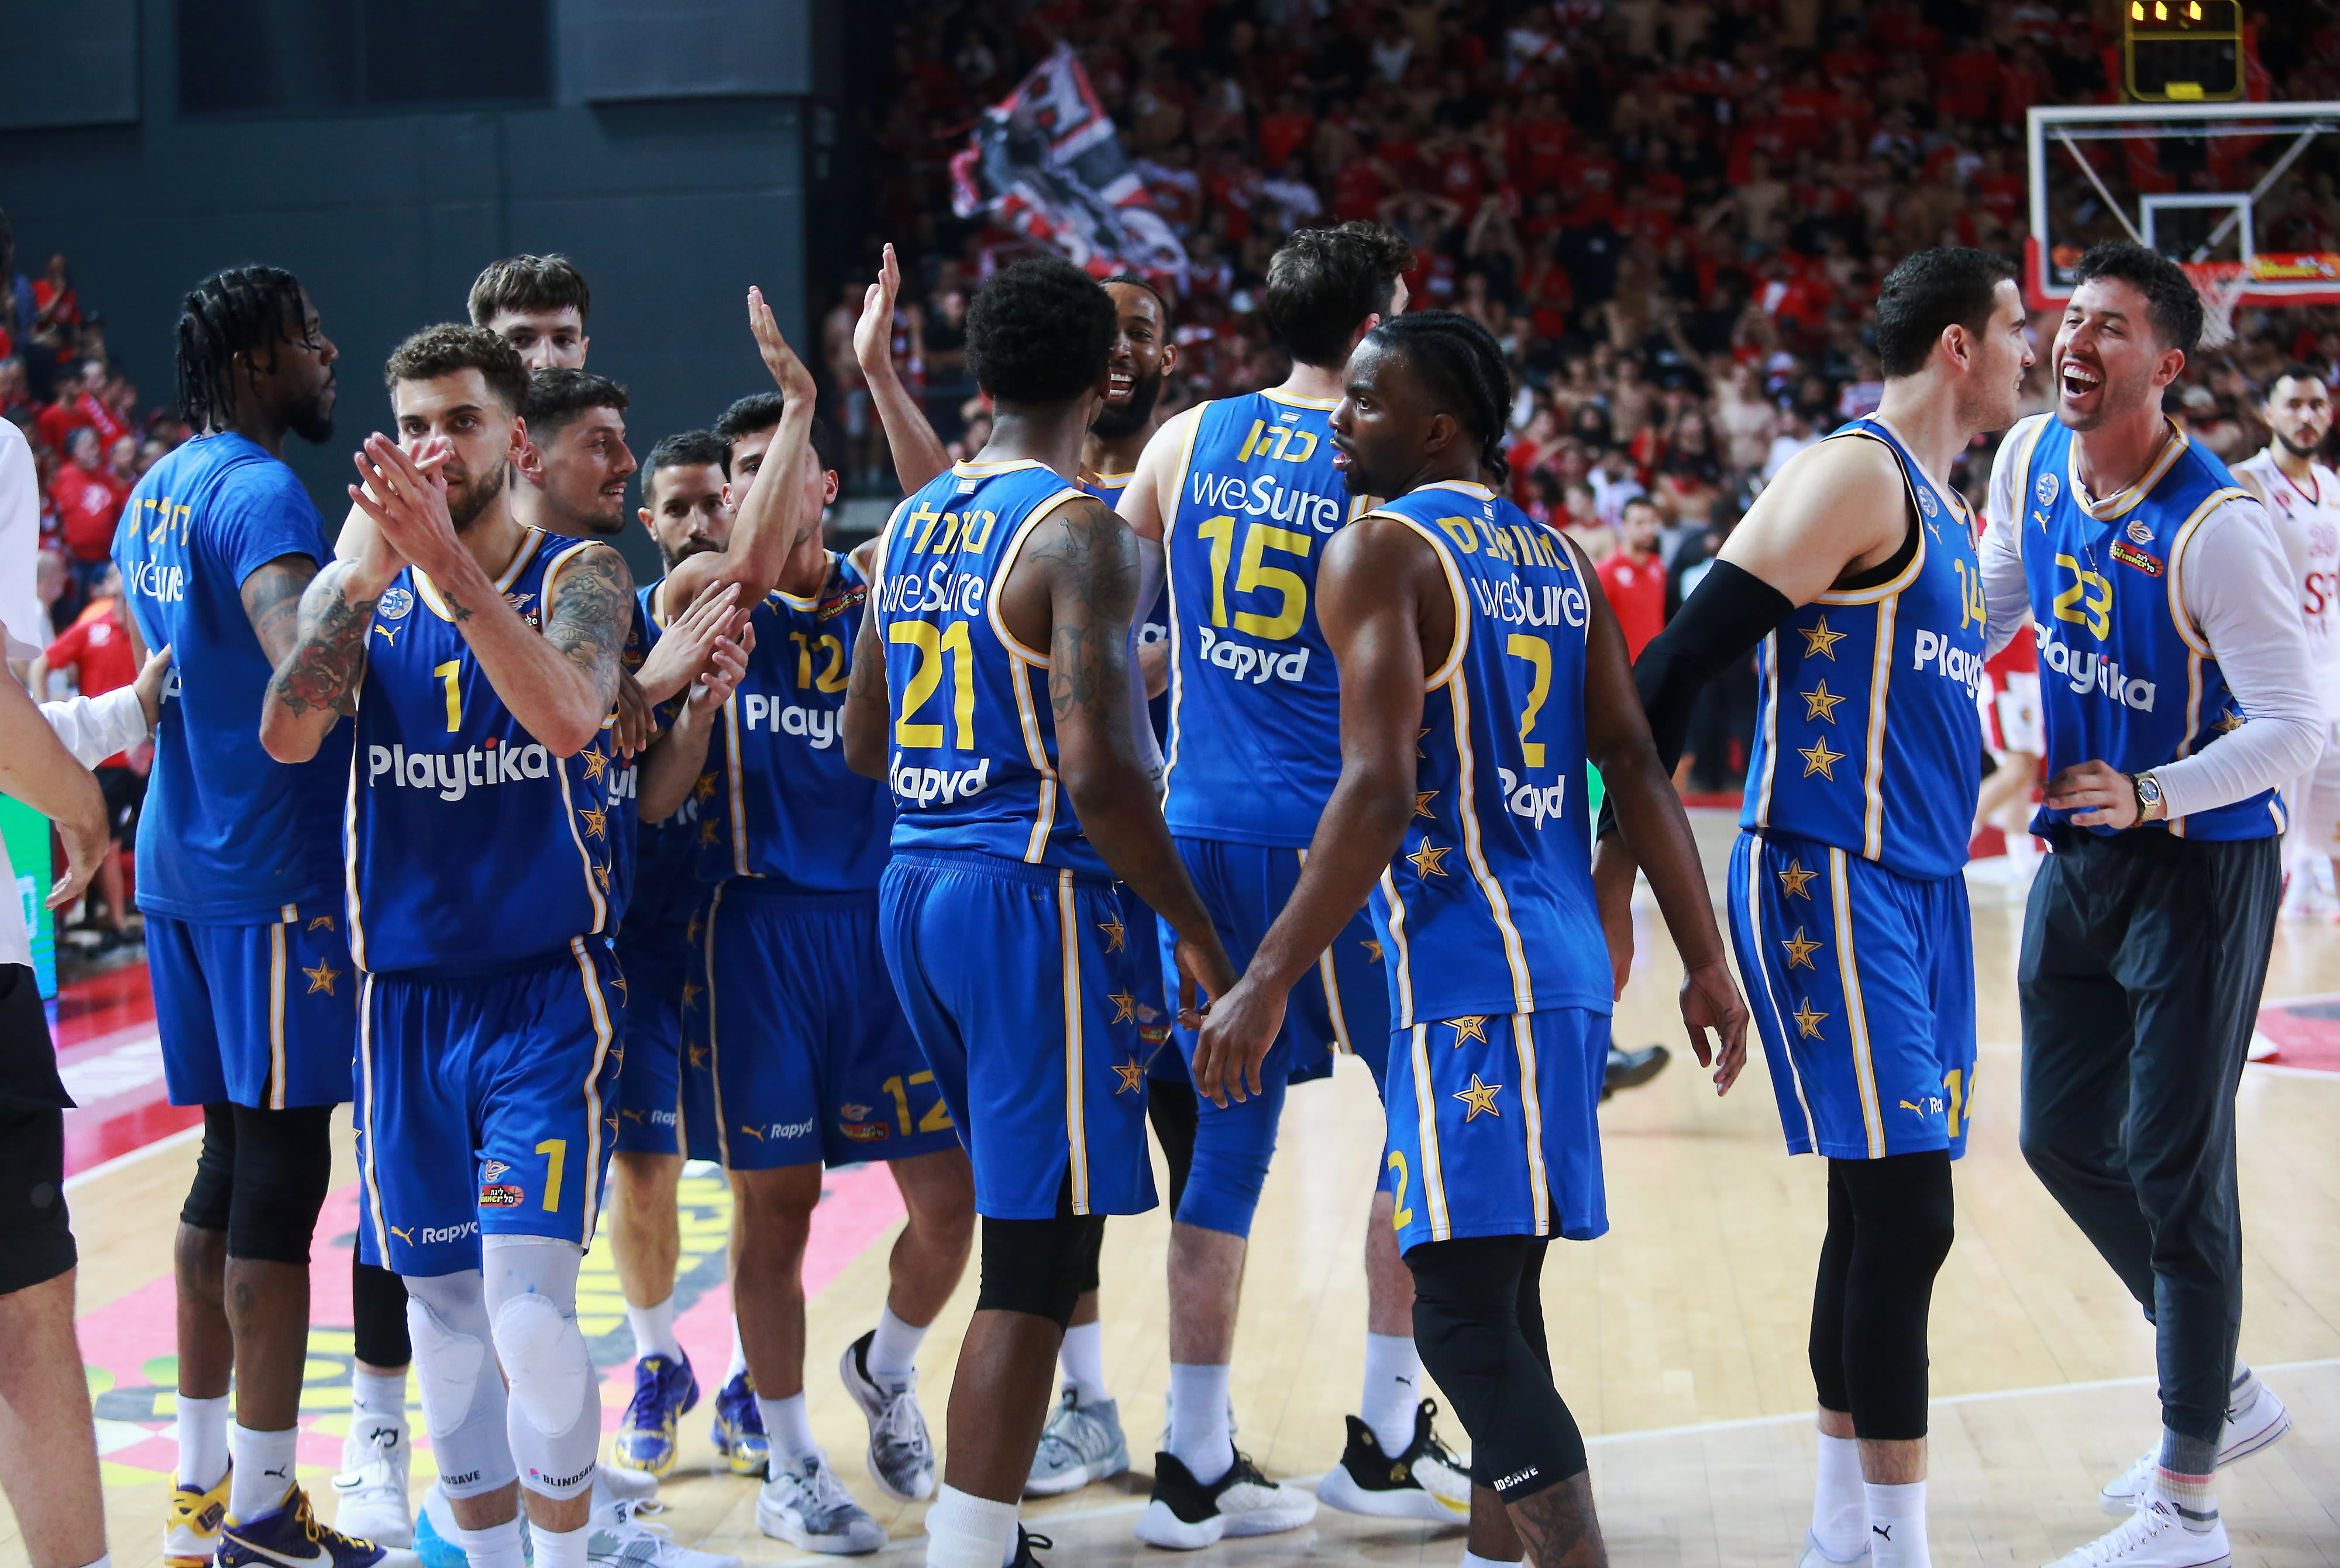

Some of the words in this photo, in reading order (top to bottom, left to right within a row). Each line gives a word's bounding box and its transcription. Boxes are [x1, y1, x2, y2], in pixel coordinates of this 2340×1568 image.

[1237, 419, 1318, 463] כהן
[1193, 471, 1340, 533] weSure
[882, 560, 985, 616] weSure
[1198, 515, 1312, 640] 15
[1471, 572, 1584, 627] weSure
[1954, 558, 1987, 639] 14
[2053, 552, 2113, 642] 23
[789, 630, 849, 694] 12
[889, 619, 974, 750] 21
[433, 659, 461, 733] 1
[1506, 633, 1552, 769] 2
[369, 737, 550, 802] Playtika
[1463, 1019, 1474, 1028] 05
[770, 1116, 813, 1140] Rapyd
[882, 1070, 958, 1136] 12
[1476, 1093, 1484, 1102] 14
[490, 1187, 504, 1196] ליגת
[504, 1193, 514, 1203] סל
[535, 1138, 567, 1212] 1
[1387, 1150, 1413, 1231] 2
